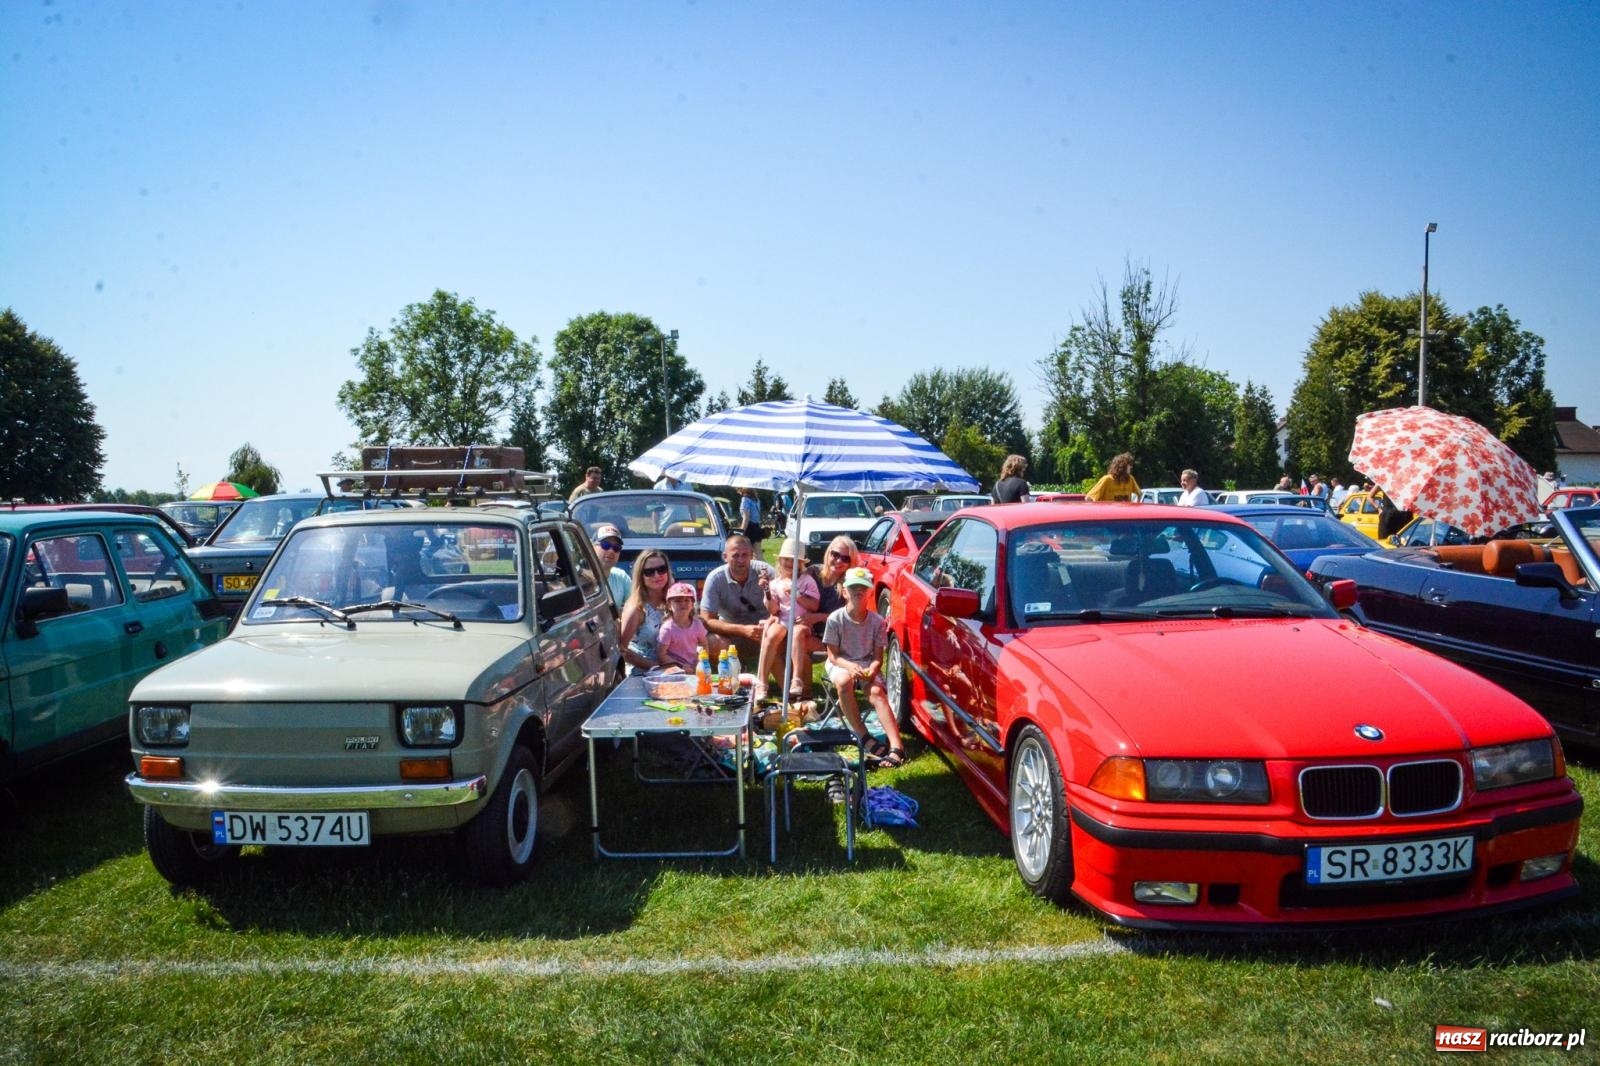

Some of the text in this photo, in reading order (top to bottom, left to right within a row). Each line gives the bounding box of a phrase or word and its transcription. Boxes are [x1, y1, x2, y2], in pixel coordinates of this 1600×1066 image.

[229, 814, 363, 842] DW 5374U
[1327, 838, 1469, 879] SR 8333K
[1308, 870, 1319, 878] PL
